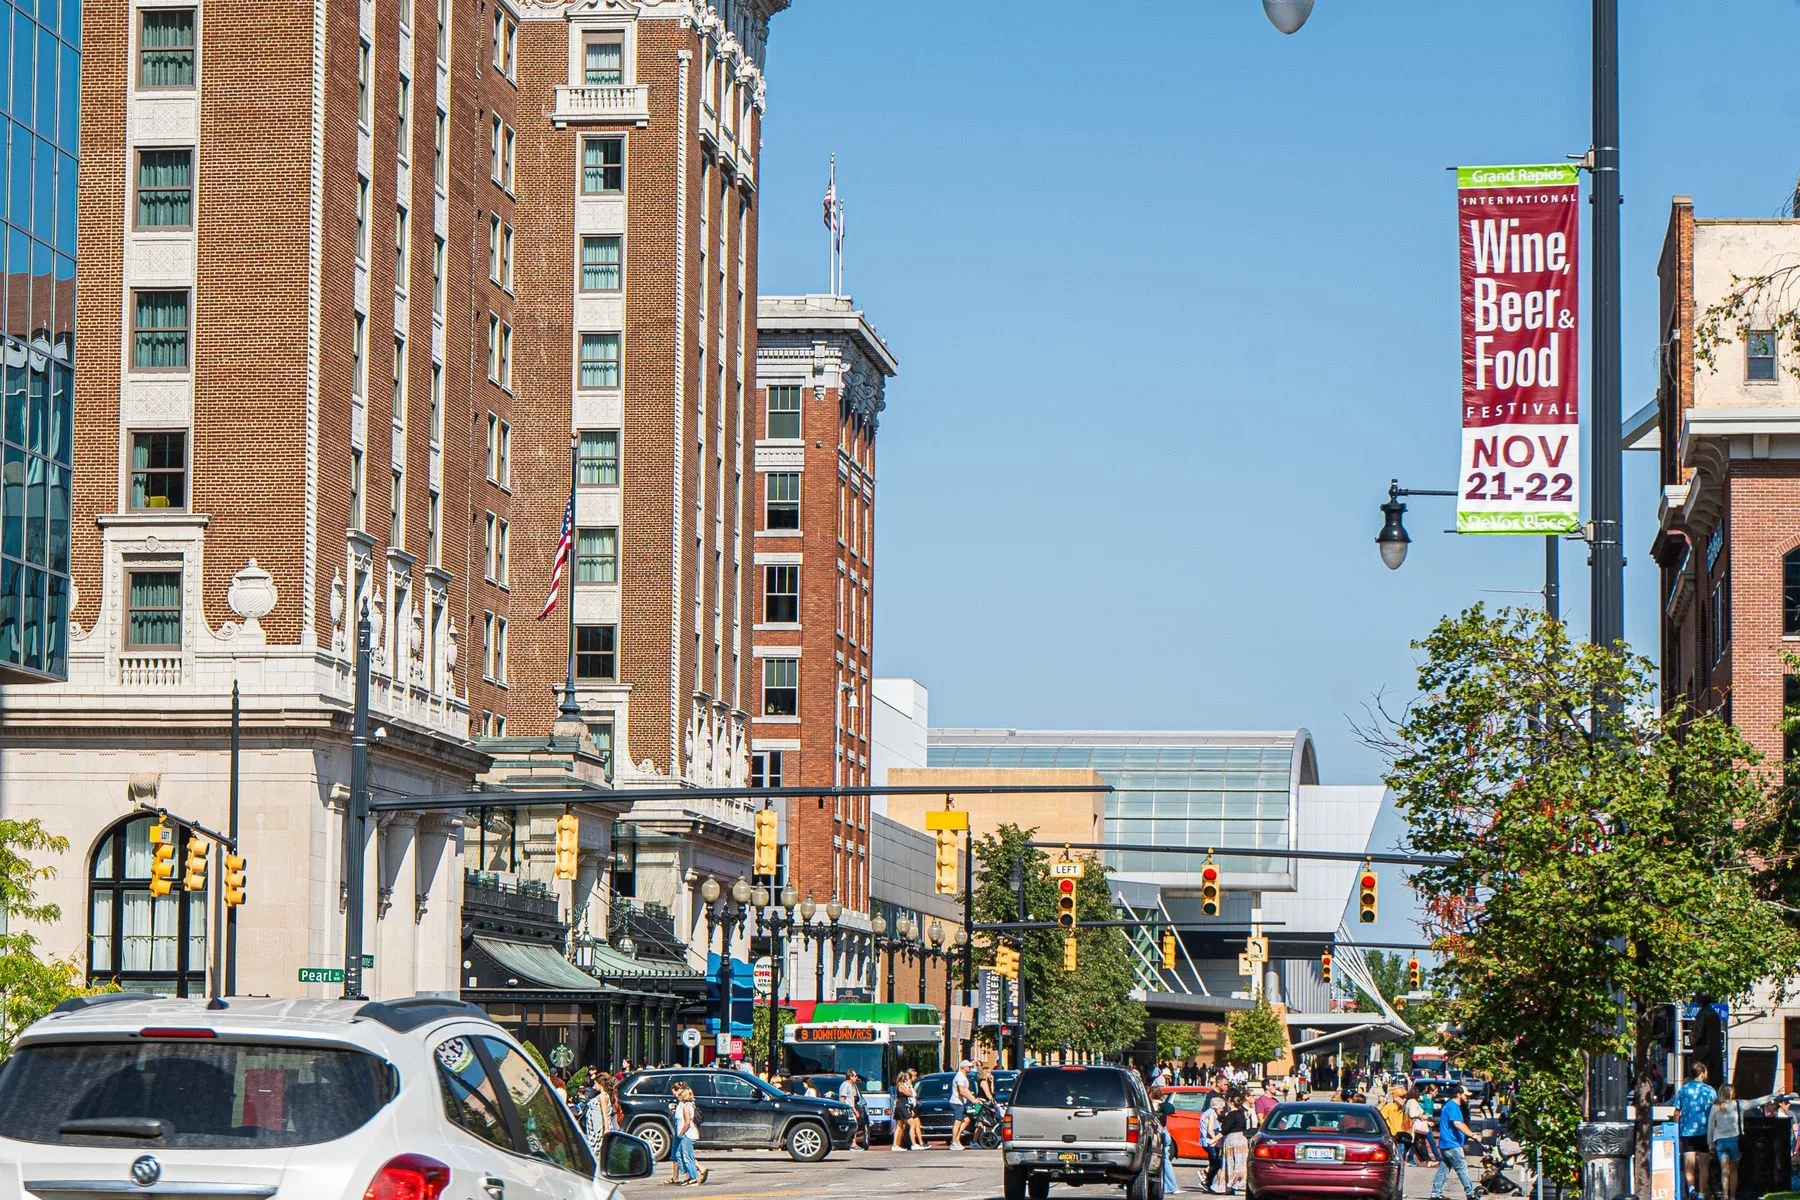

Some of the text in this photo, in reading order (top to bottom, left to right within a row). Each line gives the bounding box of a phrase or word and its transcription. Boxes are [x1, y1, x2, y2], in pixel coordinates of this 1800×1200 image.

[1471, 167, 1565, 184] Grand Rapids
[1461, 193, 1577, 206] INTERNATIONAL
[1470, 218, 1571, 275] Wine,
[1474, 277, 1561, 333] Beer
[1475, 331, 1560, 391] Food
[1466, 402, 1576, 419] FESTIVAL
[1471, 434, 1570, 469] NOV
[1465, 471, 1574, 502] 21-22
[1523, 514, 1567, 529] Place
[1056, 865, 1078, 874] LEFT
[301, 969, 332, 982] Pearl
[801, 1028, 809, 1041] 9
[812, 1028, 873, 1041] DOWNTOWN/RCS
